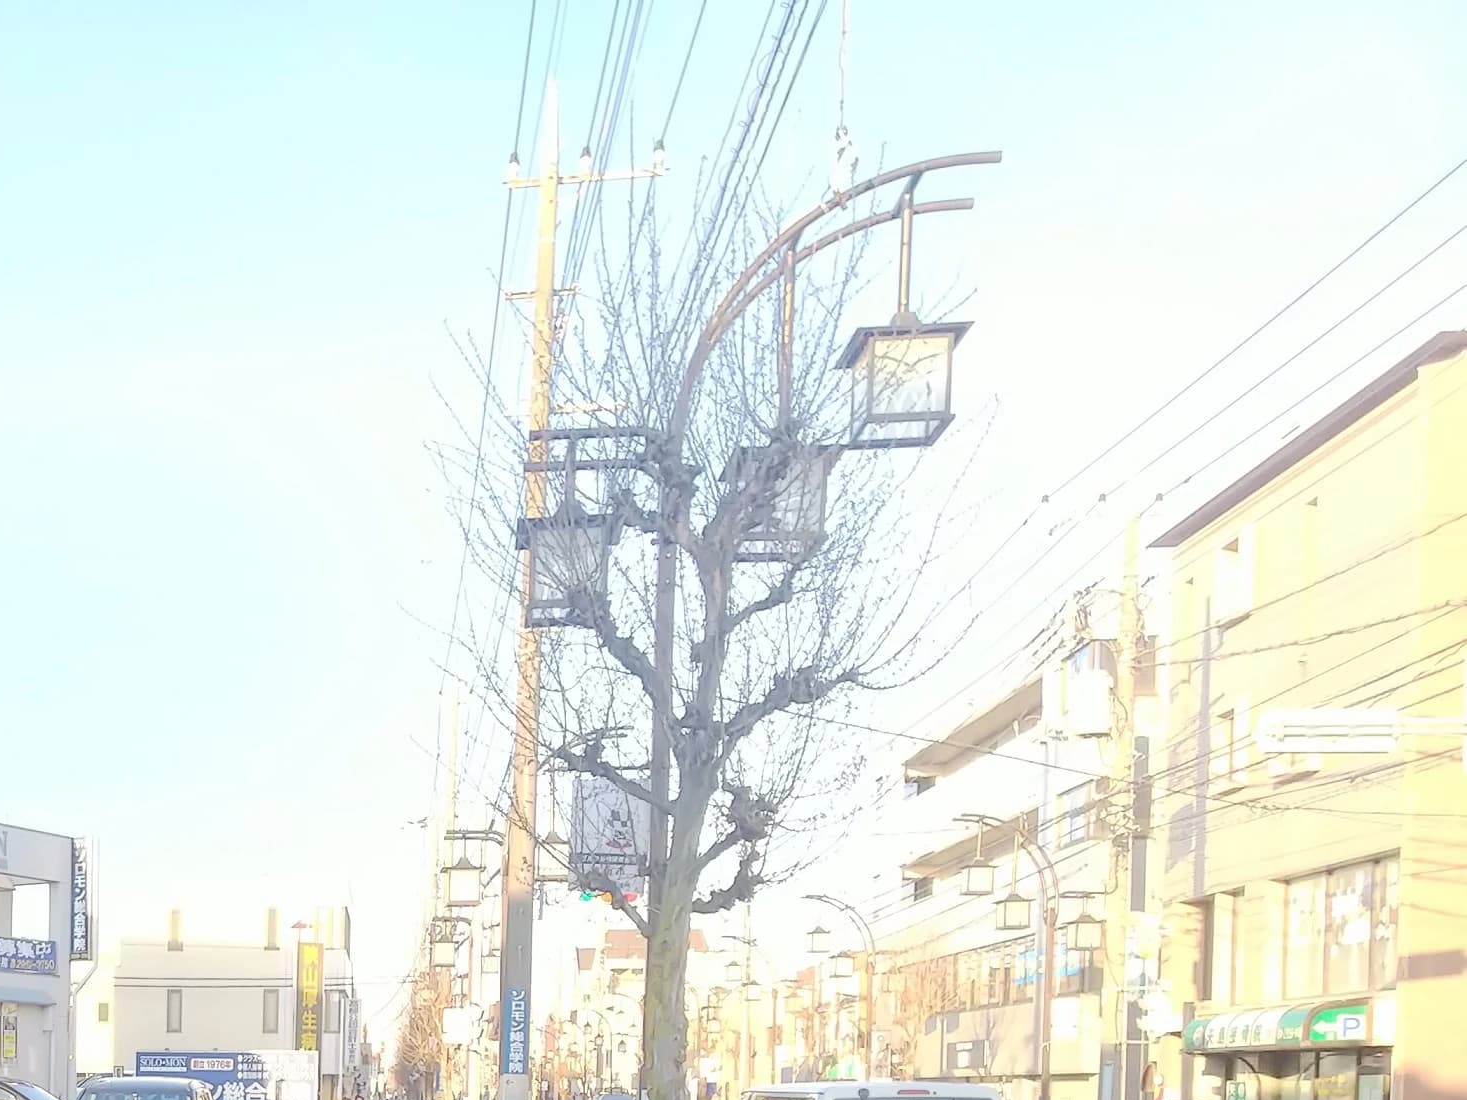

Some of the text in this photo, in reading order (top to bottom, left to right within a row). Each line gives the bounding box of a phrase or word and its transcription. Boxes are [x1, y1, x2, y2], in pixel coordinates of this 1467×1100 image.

[509, 990, 526, 1073] ソロモン総合学院
[1343, 1017, 1361, 1038] P
